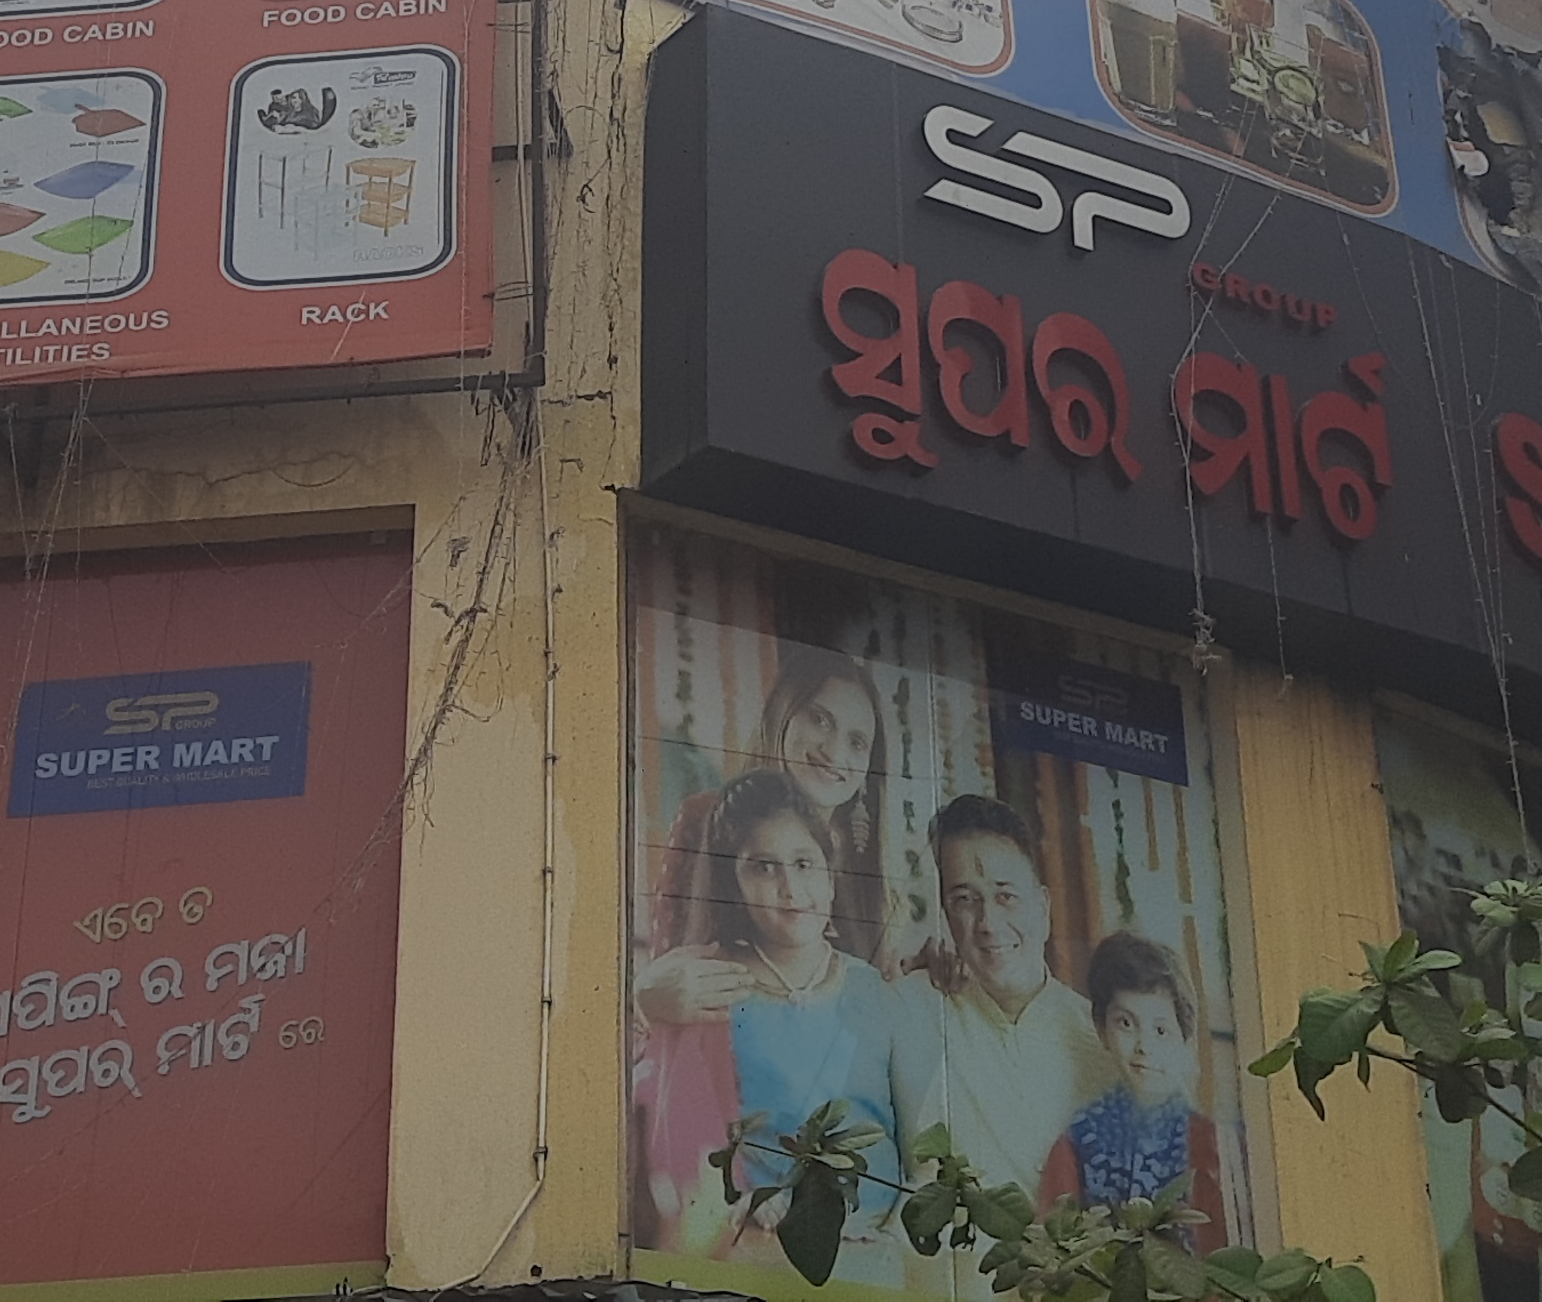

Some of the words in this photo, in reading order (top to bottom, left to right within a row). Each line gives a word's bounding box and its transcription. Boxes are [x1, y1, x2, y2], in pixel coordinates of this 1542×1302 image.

[61, 19, 155, 43] CABIN
[262, 4, 347, 28] FOOD
[923, 105, 1191, 251] SP
[300, 301, 390, 327] RACK
[1190, 261, 1338, 331] GROUP
[104, 691, 220, 735] SP
[1019, 700, 1099, 738] SUPER
[1104, 720, 1170, 754] MART
[35, 745, 160, 779] SUPER
[172, 735, 280, 768] MART
